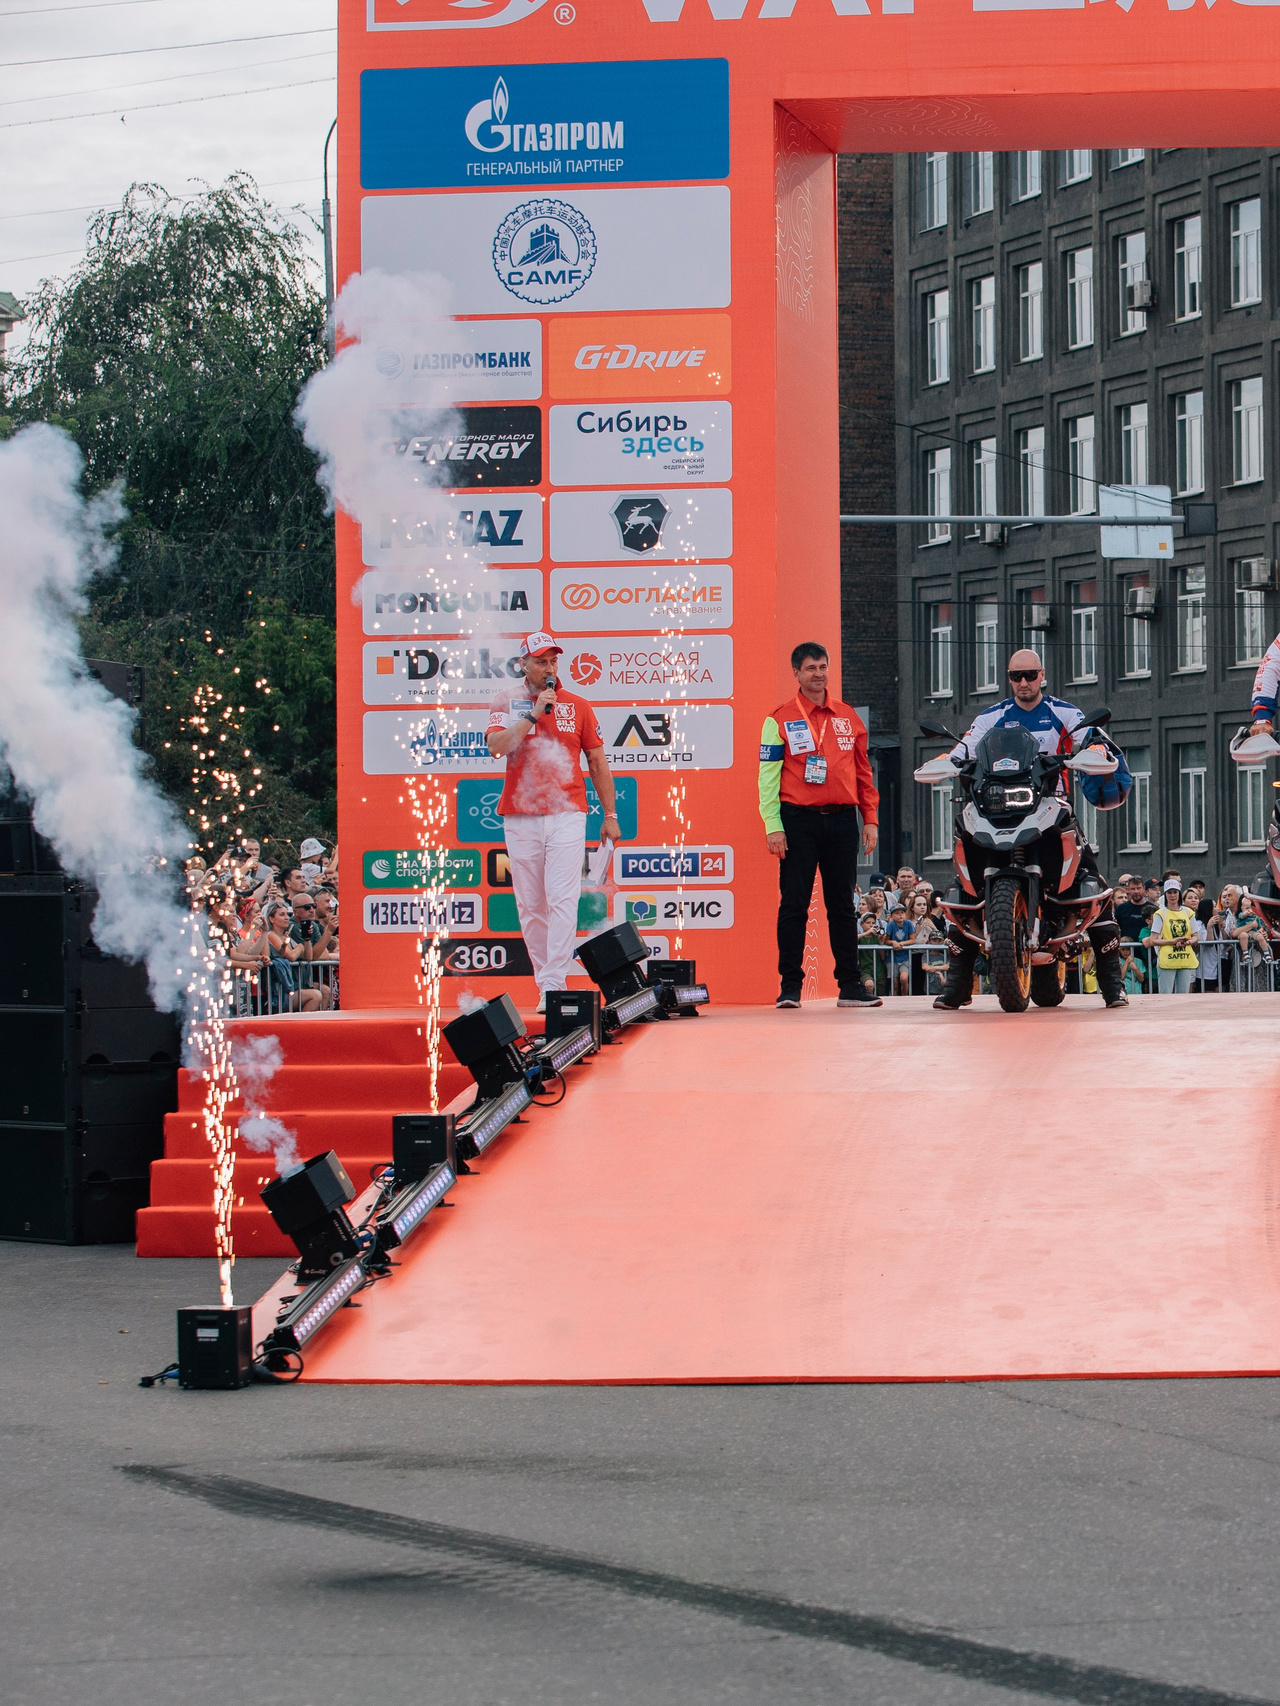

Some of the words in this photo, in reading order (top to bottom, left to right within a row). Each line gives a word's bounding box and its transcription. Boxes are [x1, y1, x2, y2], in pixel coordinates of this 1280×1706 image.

[513, 121, 624, 152] ГАЗПРОМ
[466, 158, 562, 176] ГЕНЕРАЛЬНЫЙ
[566, 158, 624, 173] ПАРТНЕР
[507, 270, 582, 286] CAMF
[413, 351, 531, 370] ГАЗПРОМБАНК
[576, 409, 688, 437] Сибирь
[498, 433, 534, 441] МАСЛО
[621, 436, 705, 458] здесь
[375, 590, 530, 614] MONGOLIA
[603, 586, 723, 604] СОГЛАСИЕ
[406, 648, 527, 680] Delko
[609, 651, 700, 667] РУССКАЯ
[609, 668, 714, 685] МЕХАНИКА
[556, 719, 576, 727] SILK
[557, 725, 576, 734] WAY
[439, 731, 487, 748] ГАЗПРО
[837, 736, 856, 744] SILK
[605, 752, 693, 763] ЕНЗОЛОТО
[396, 860, 419, 869] РИА
[422, 859, 474, 868] ОВОСТИ
[627, 856, 693, 874] РОССИЯ
[703, 856, 723, 872] 24
[396, 869, 433, 877] СПОРТ
[663, 900, 723, 919] 2ГИС
[454, 945, 507, 969] 360
